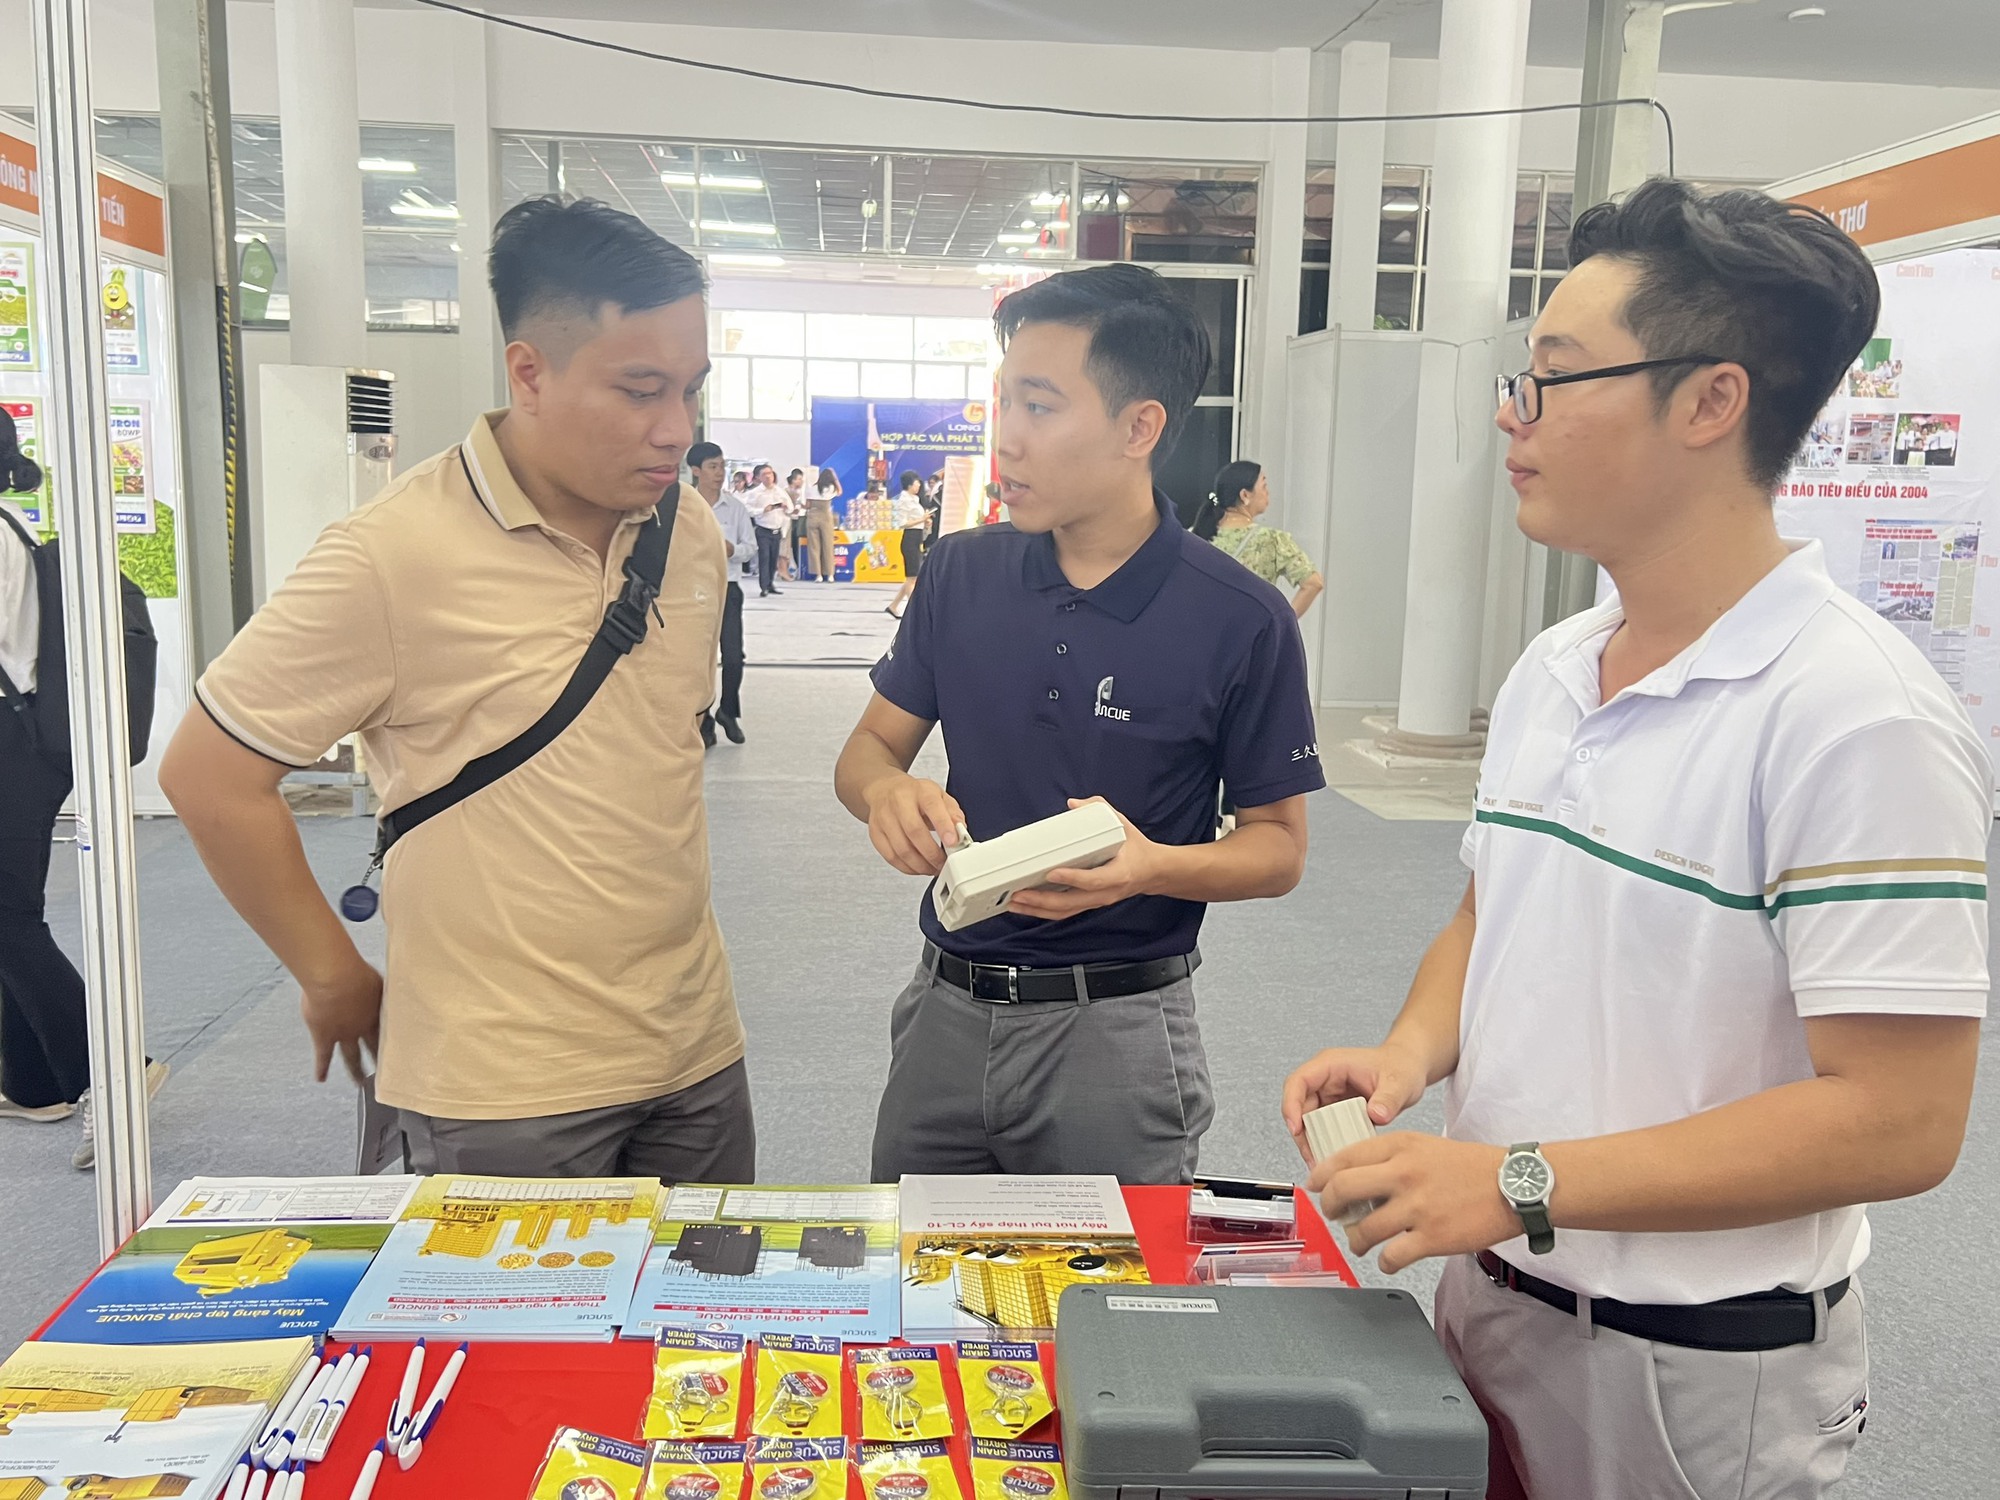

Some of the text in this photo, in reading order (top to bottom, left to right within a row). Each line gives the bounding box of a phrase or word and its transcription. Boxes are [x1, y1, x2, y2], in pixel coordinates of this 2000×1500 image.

[1839, 200, 1867, 233] THƠ
[881, 432, 904, 443] HỢP
[906, 432, 928, 442] TÁC
[930, 432, 945, 442] VÀ
[947, 433, 974, 443] PHÁT
[1791, 481, 1814, 497] BÁO
[1818, 481, 1842, 498] TIÊU
[1845, 480, 1871, 498] BIỂU
[1874, 481, 1897, 498] CỦA
[1900, 486, 1928, 499] 2004
[387, 1303, 440, 1311] SUNCUE
[95, 1313, 166, 1323] SUNCUE
[694, 1312, 752, 1321] SUNCUE
[667, 1330, 696, 1339] DRYER
[764, 1334, 793, 1342] DRYER
[665, 1337, 695, 1346] GRAIN
[763, 1340, 835, 1352] SUNCUE GRAIN
[961, 1342, 990, 1350] DRYER
[962, 1349, 1033, 1359] SUNCUE GRAIN
[861, 1443, 893, 1453] DRYER
[976, 1438, 1007, 1448] DRYER
[597, 1443, 644, 1463] SUNCUE
[694, 1450, 740, 1461] SUNCUE
[760, 1450, 793, 1459] GRAIN
[976, 1446, 1054, 1459] SUNCUE GRAIN
[1005, 1476, 1047, 1492] SUNCUE
